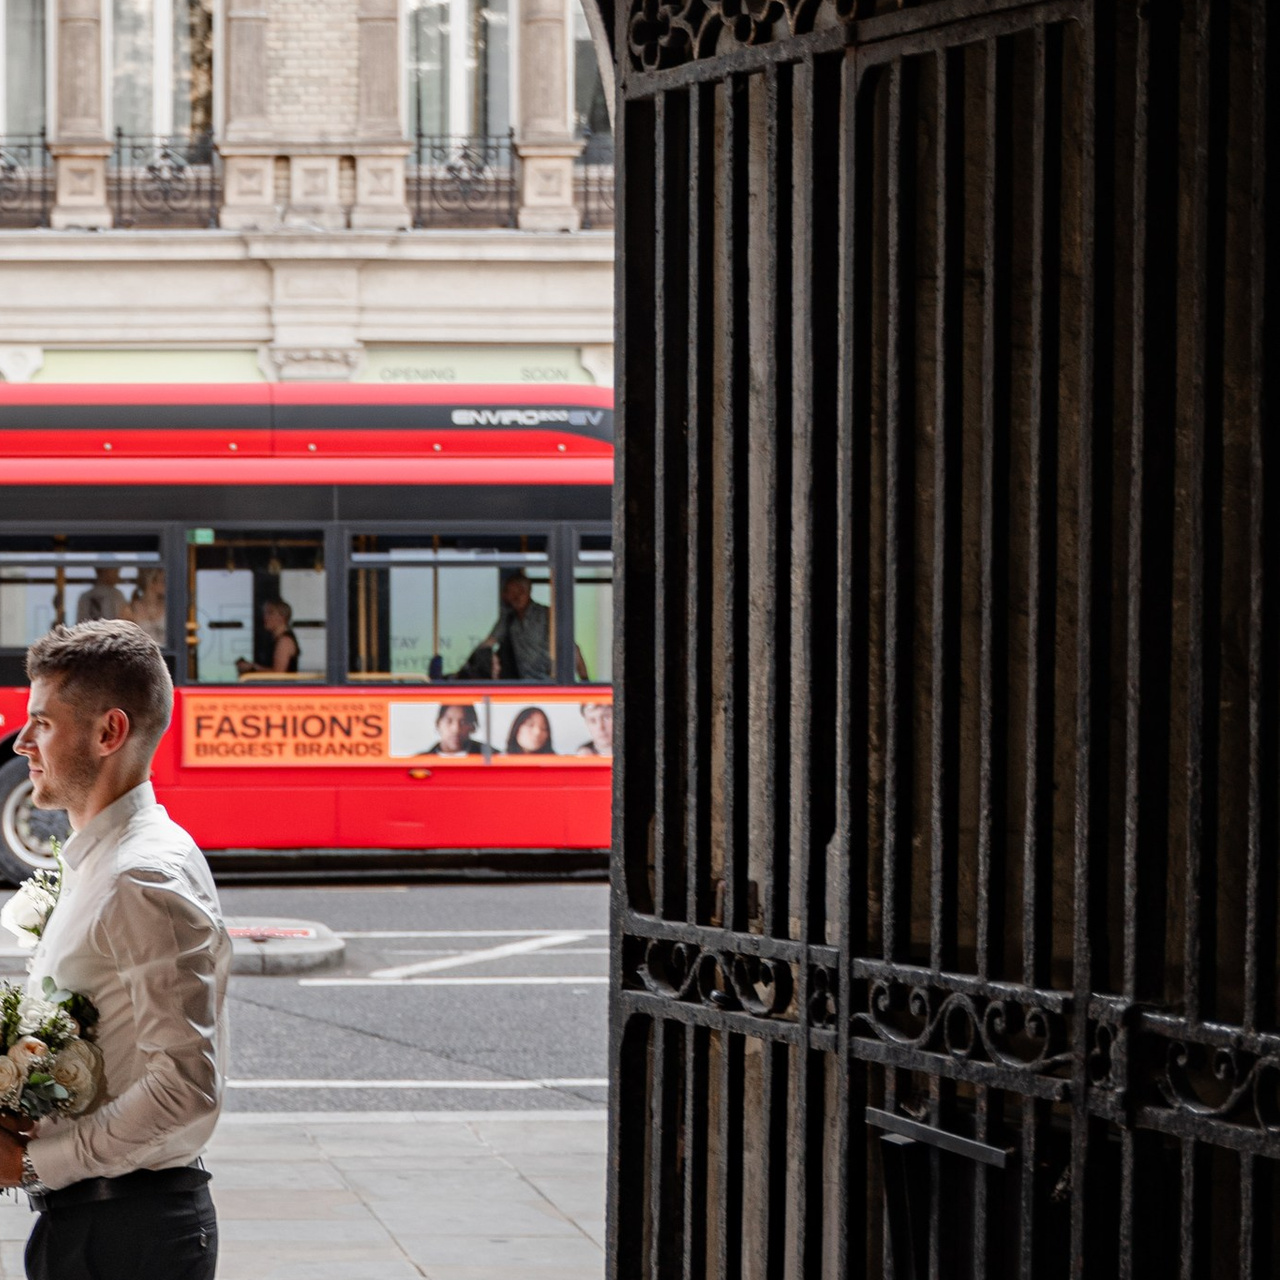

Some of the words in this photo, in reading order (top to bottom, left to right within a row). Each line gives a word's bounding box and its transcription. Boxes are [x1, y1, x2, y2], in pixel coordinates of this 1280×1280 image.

[379, 367, 456, 382] OPENING
[520, 367, 569, 382] SOON
[195, 715, 383, 738] FASHION'S
[195, 742, 286, 757] BIGGEST
[294, 742, 383, 757] BRANDS
